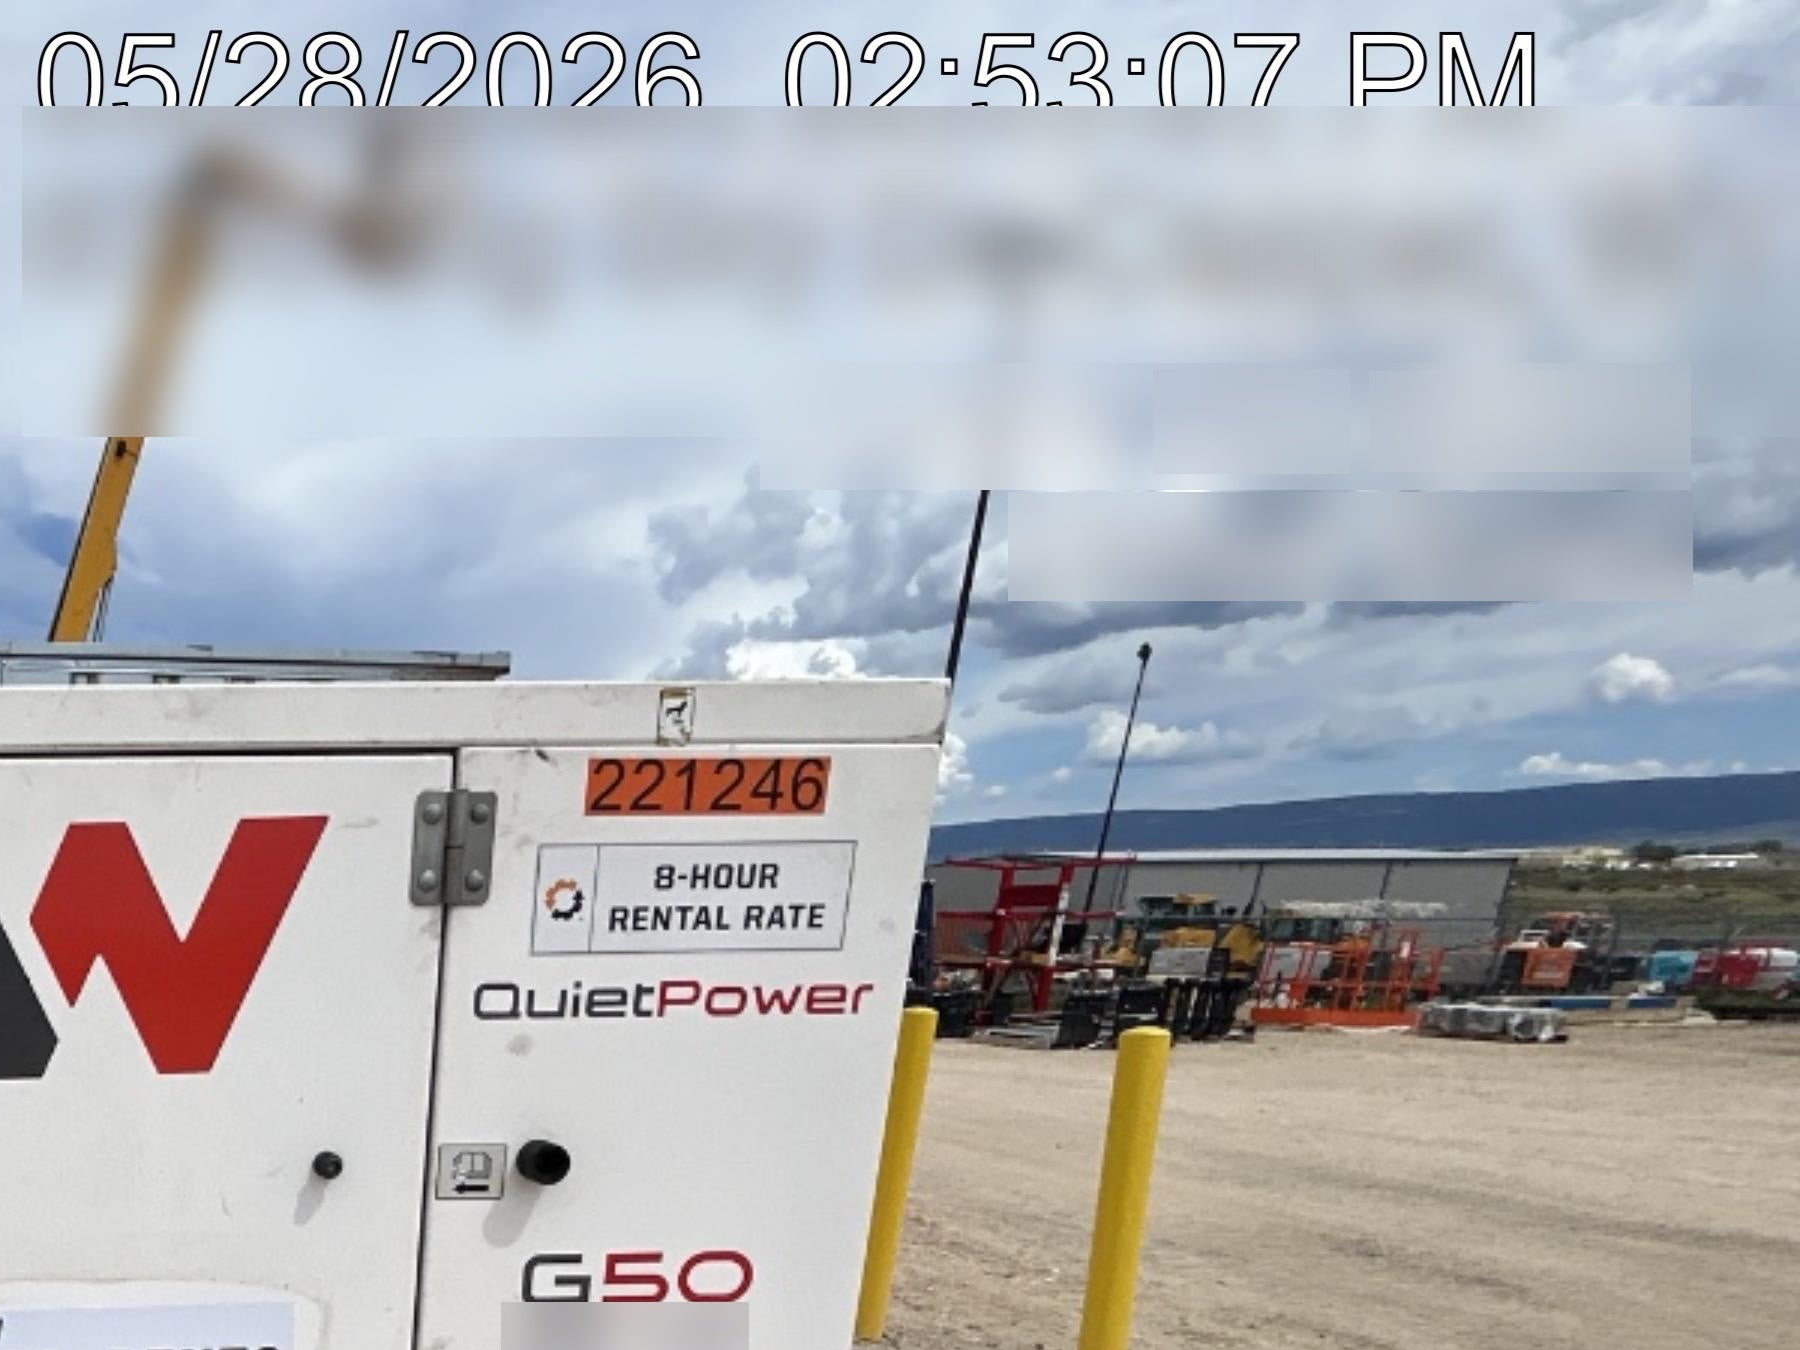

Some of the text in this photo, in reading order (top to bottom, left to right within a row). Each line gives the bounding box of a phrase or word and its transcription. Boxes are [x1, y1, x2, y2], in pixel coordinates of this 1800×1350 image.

[591, 757, 826, 812] 221246
[654, 862, 780, 891] 8-HOUR
[608, 903, 826, 932] RENTAL RATE
[473, 980, 874, 1021] QuietPower
[521, 1250, 754, 1302] G50
